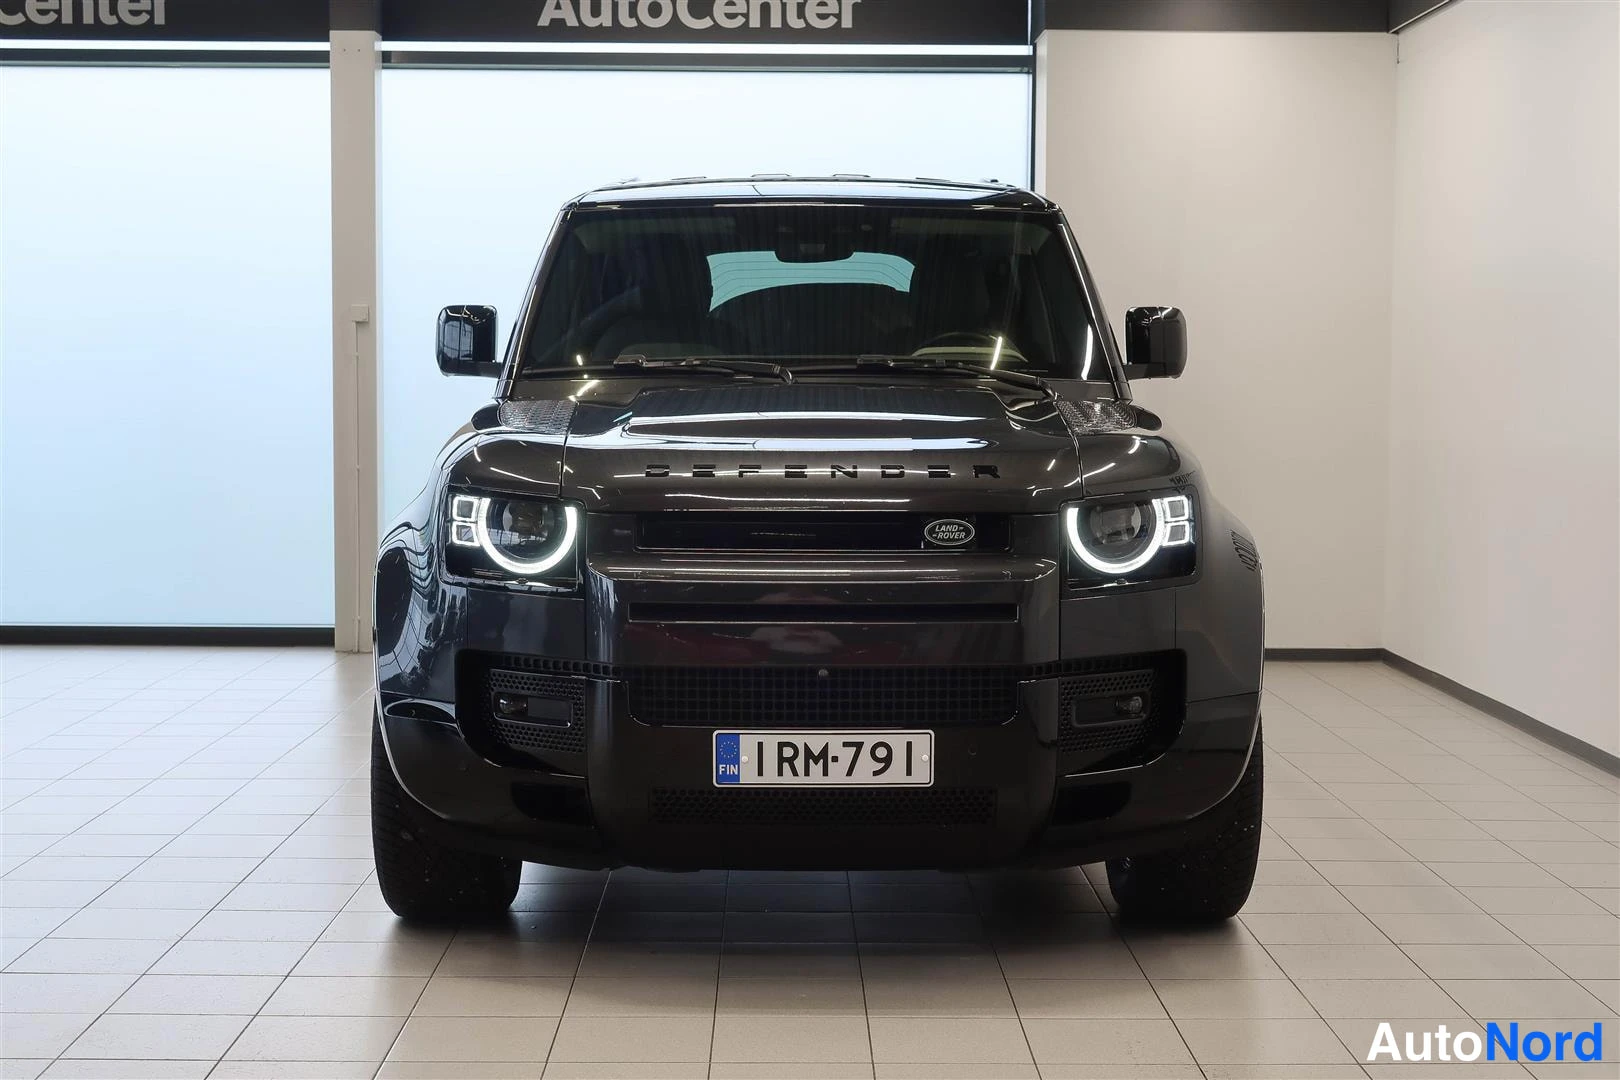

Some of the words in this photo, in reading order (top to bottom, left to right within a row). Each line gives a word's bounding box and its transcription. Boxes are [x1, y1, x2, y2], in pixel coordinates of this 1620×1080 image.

[537, 0, 862, 29] AutoCenter
[645, 464, 1001, 479] DEFENDER
[719, 764, 739, 775] FIN
[757, 741, 913, 777] IRM-791
